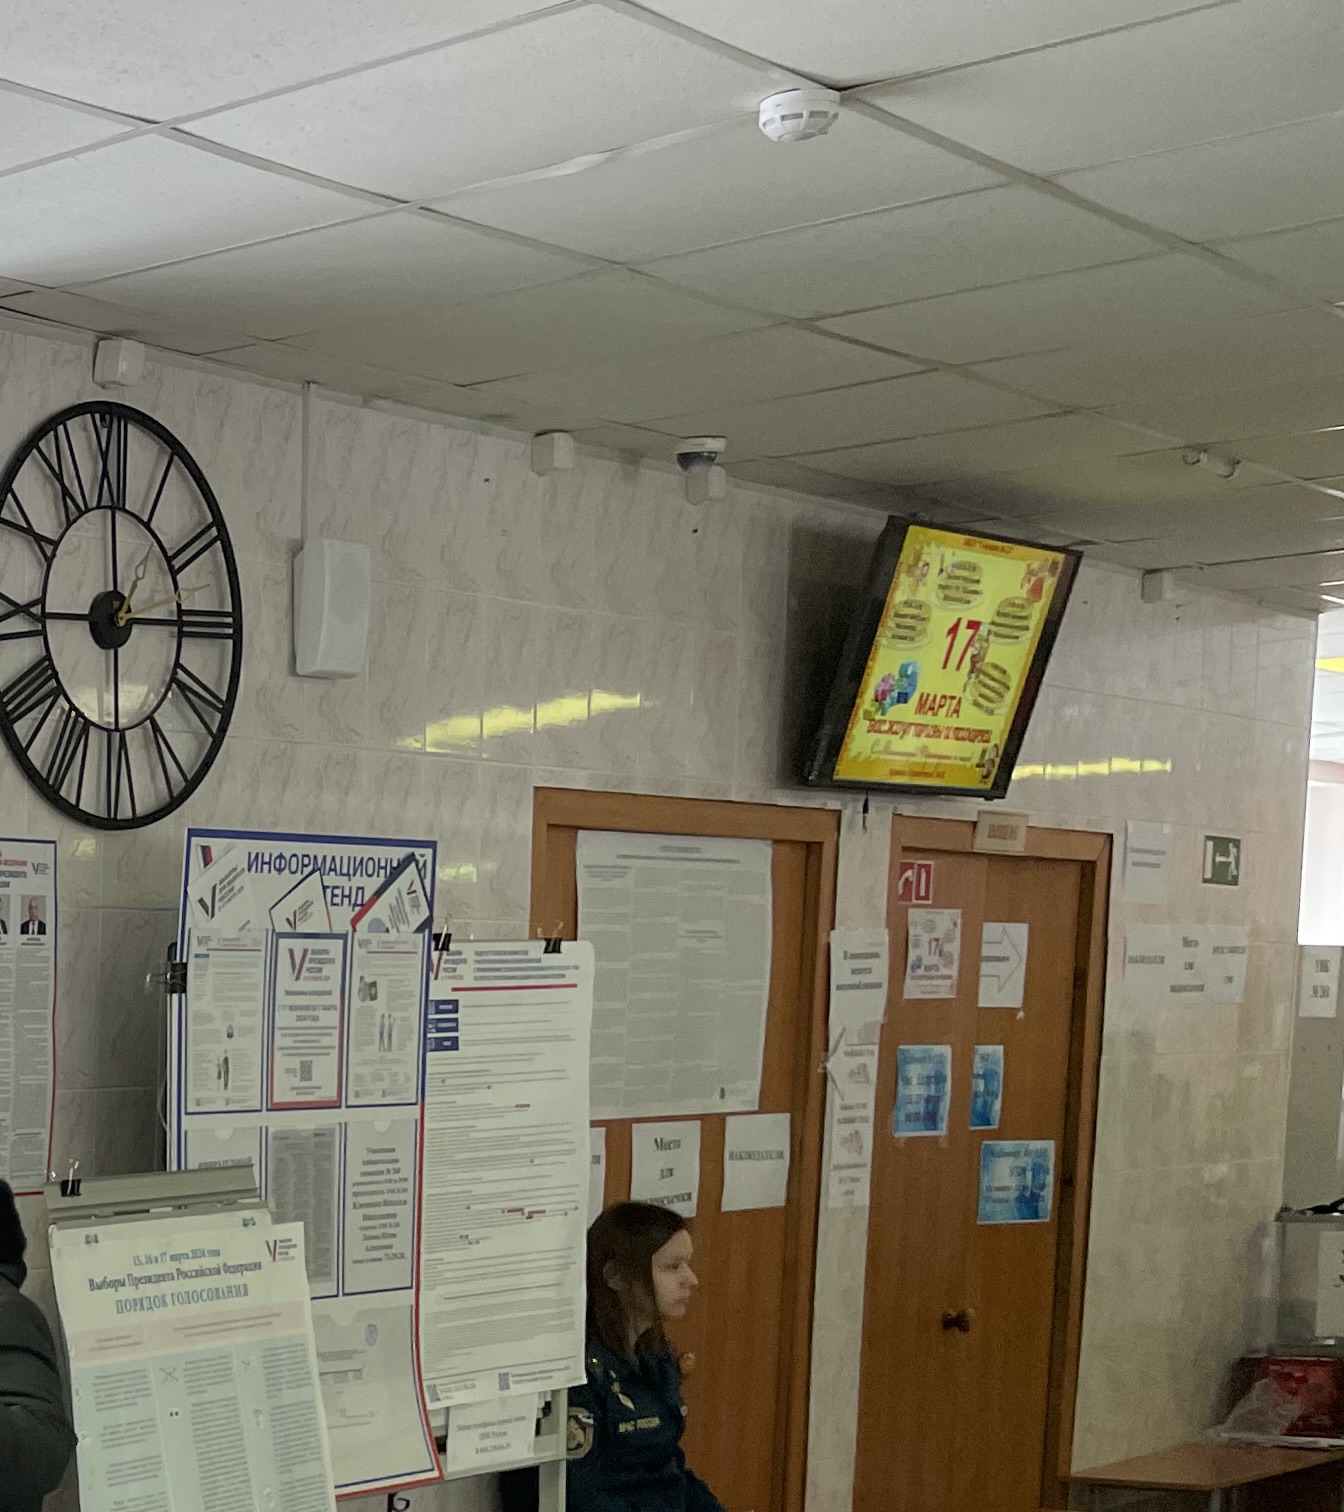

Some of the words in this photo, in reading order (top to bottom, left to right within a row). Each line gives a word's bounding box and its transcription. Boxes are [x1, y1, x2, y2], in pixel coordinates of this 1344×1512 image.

[941, 617, 983, 672] 17
[914, 691, 963, 719] МАРТА
[87, 1274, 126, 1293] Выборы
[127, 1269, 175, 1290] Президента
[115, 1293, 169, 1315] ПОРЯДОК
[170, 1283, 250, 1307] ГОЛОСОВАНИЯ
